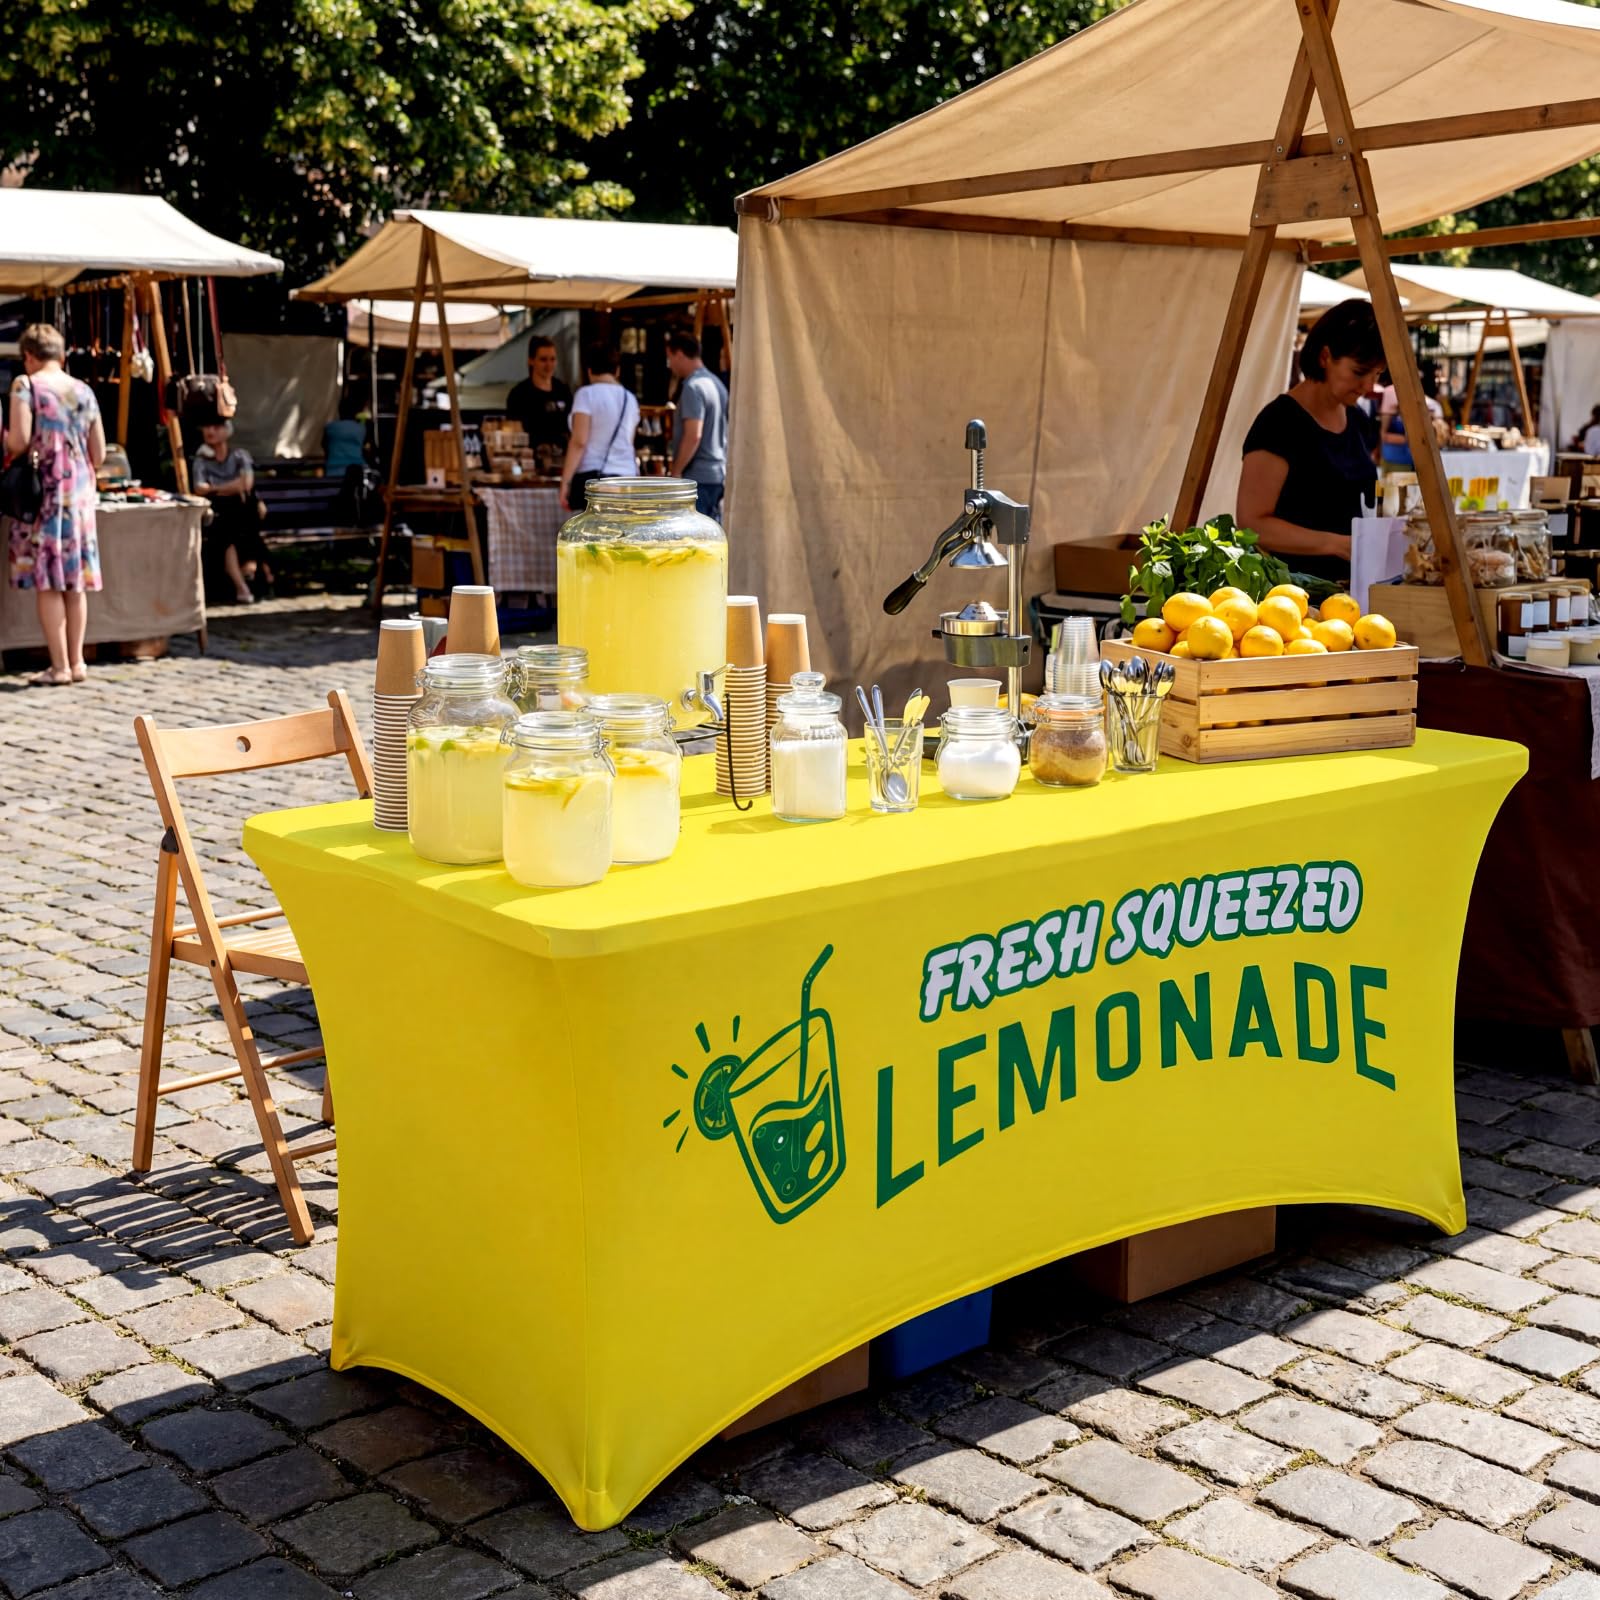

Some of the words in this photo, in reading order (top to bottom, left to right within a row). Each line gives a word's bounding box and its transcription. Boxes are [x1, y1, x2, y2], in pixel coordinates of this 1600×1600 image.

[919, 899, 1103, 1022] FRESH
[1106, 860, 1363, 959] SQUEEZED
[876, 962, 1396, 1209] LEMONADE
